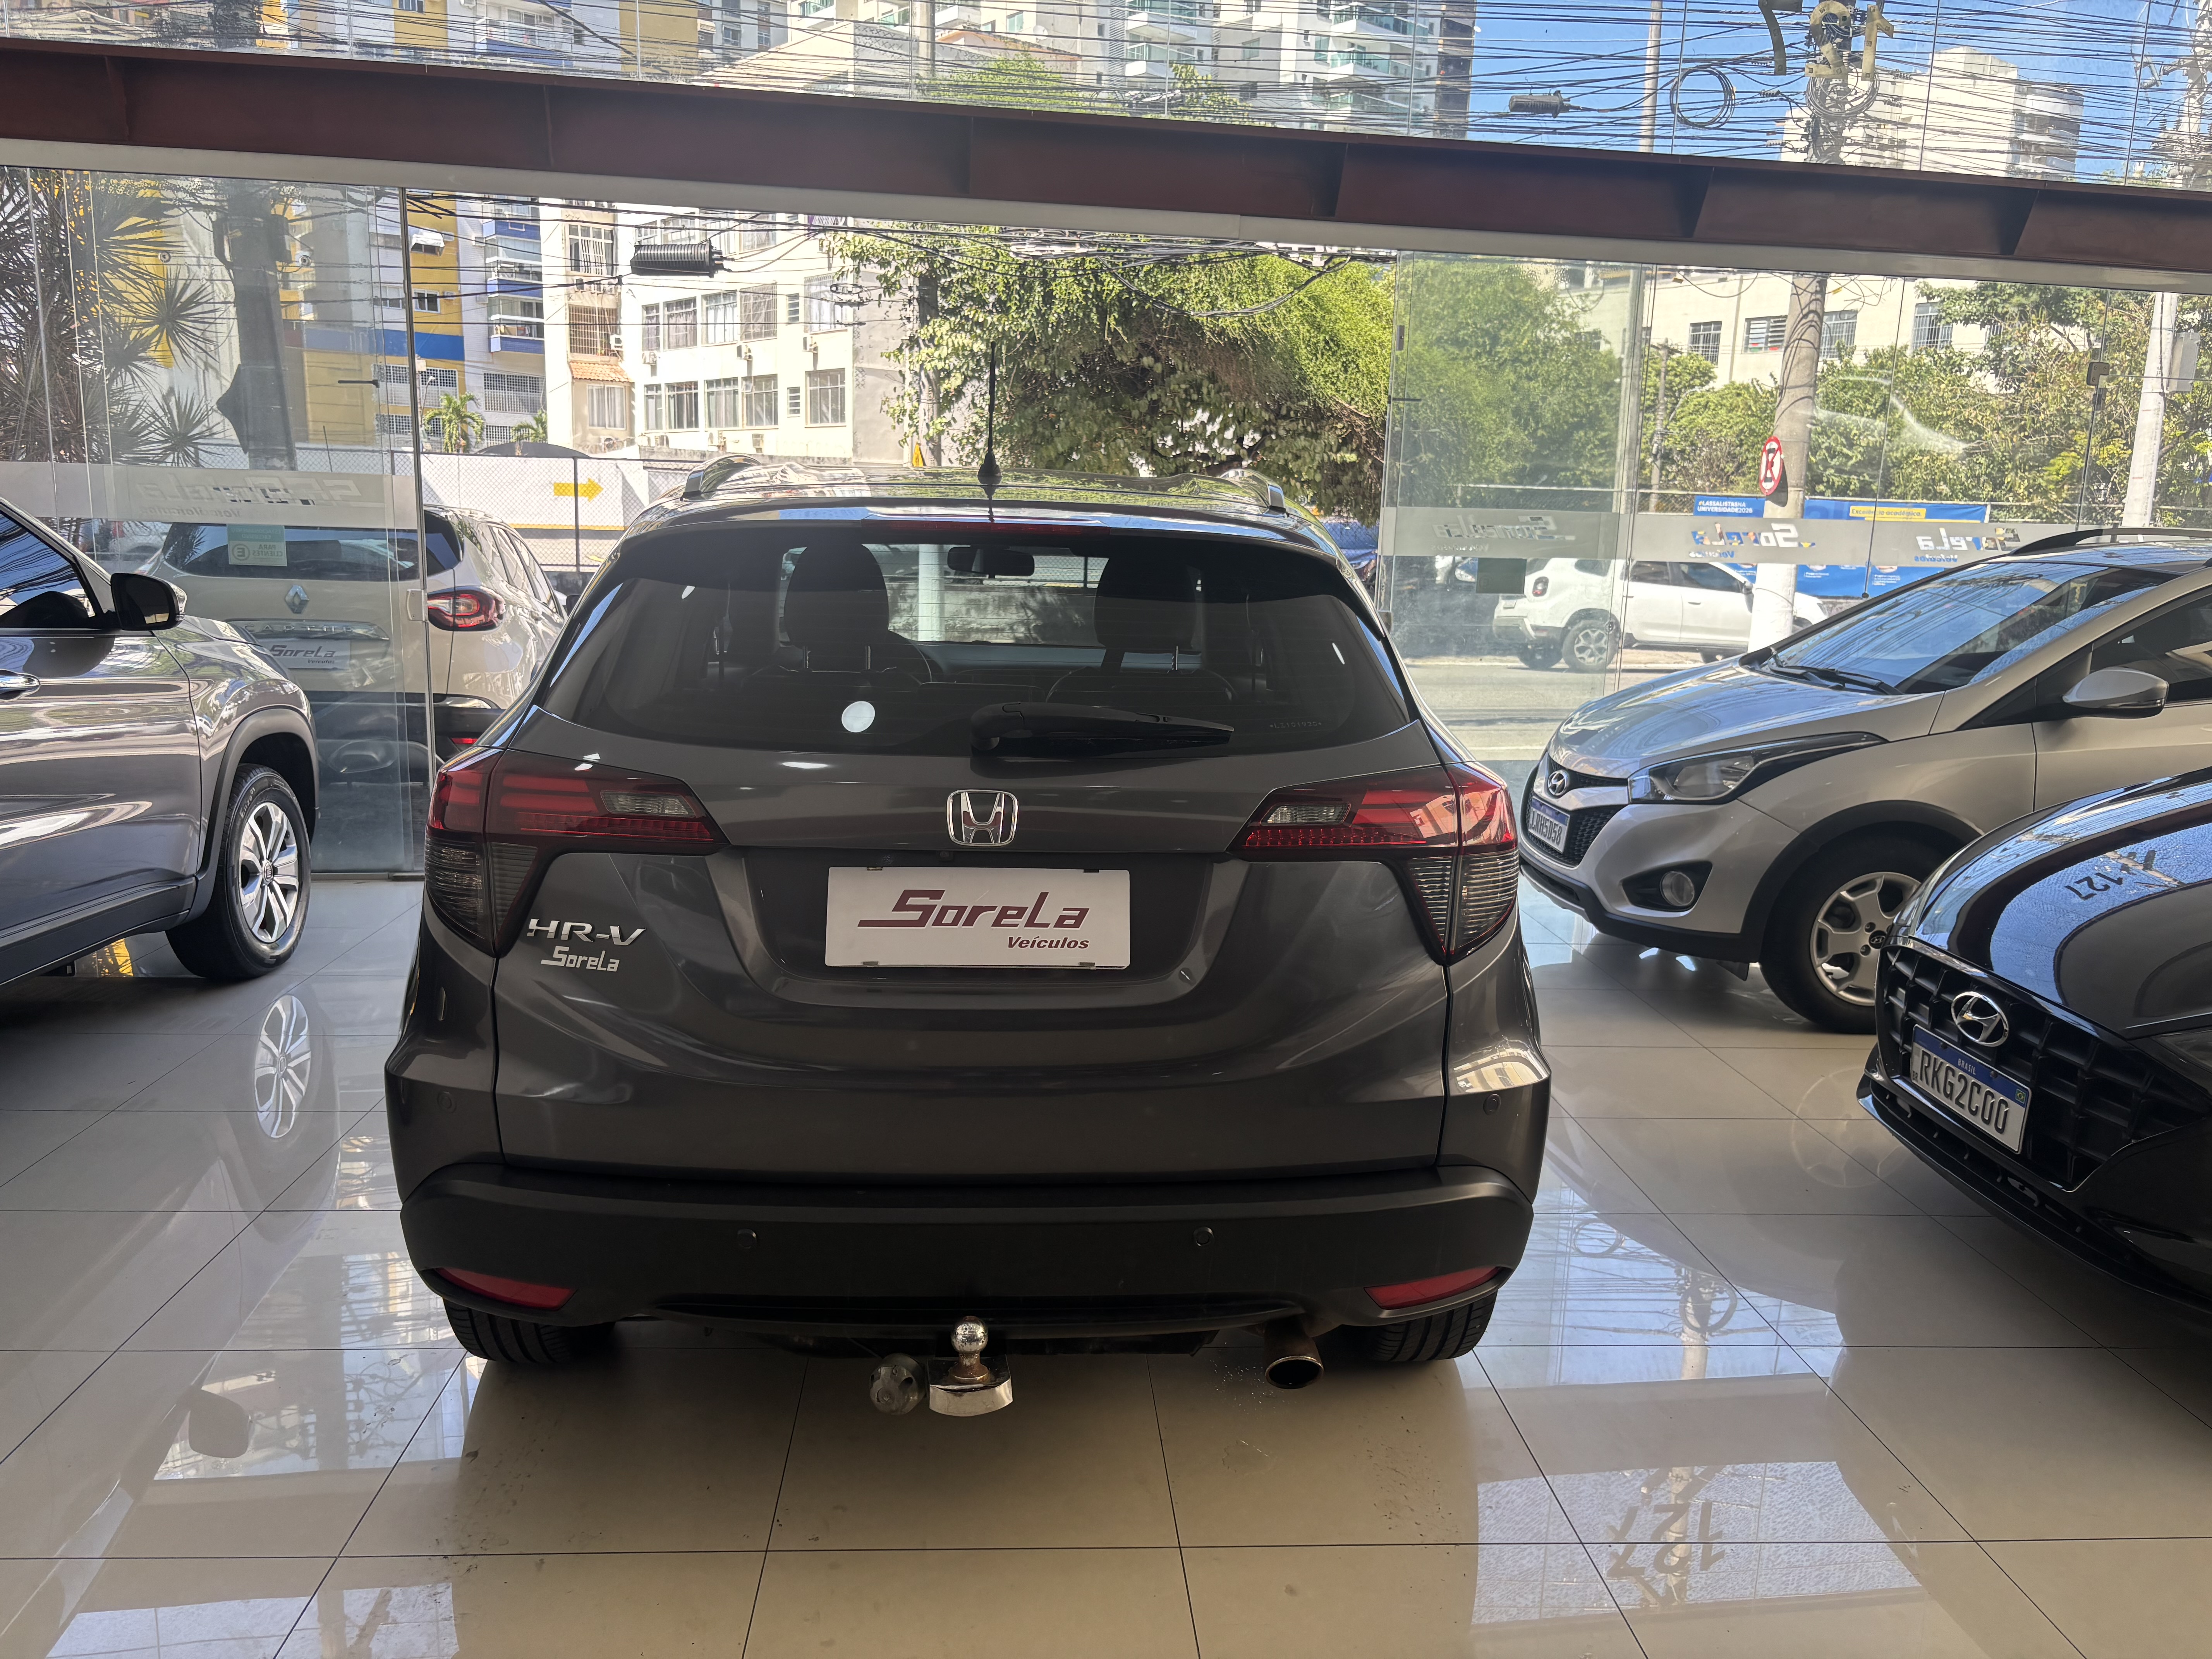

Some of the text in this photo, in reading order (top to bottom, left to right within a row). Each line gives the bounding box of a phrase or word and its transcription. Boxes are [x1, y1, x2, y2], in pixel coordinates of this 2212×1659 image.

[1531, 810, 1562, 846] LRH5D58
[527, 919, 646, 946] HR-V
[1008, 936, 1089, 949] Veículos
[1957, 1058, 1977, 1075] BRASIL
[1920, 1050, 2009, 1134] RKG2C00
